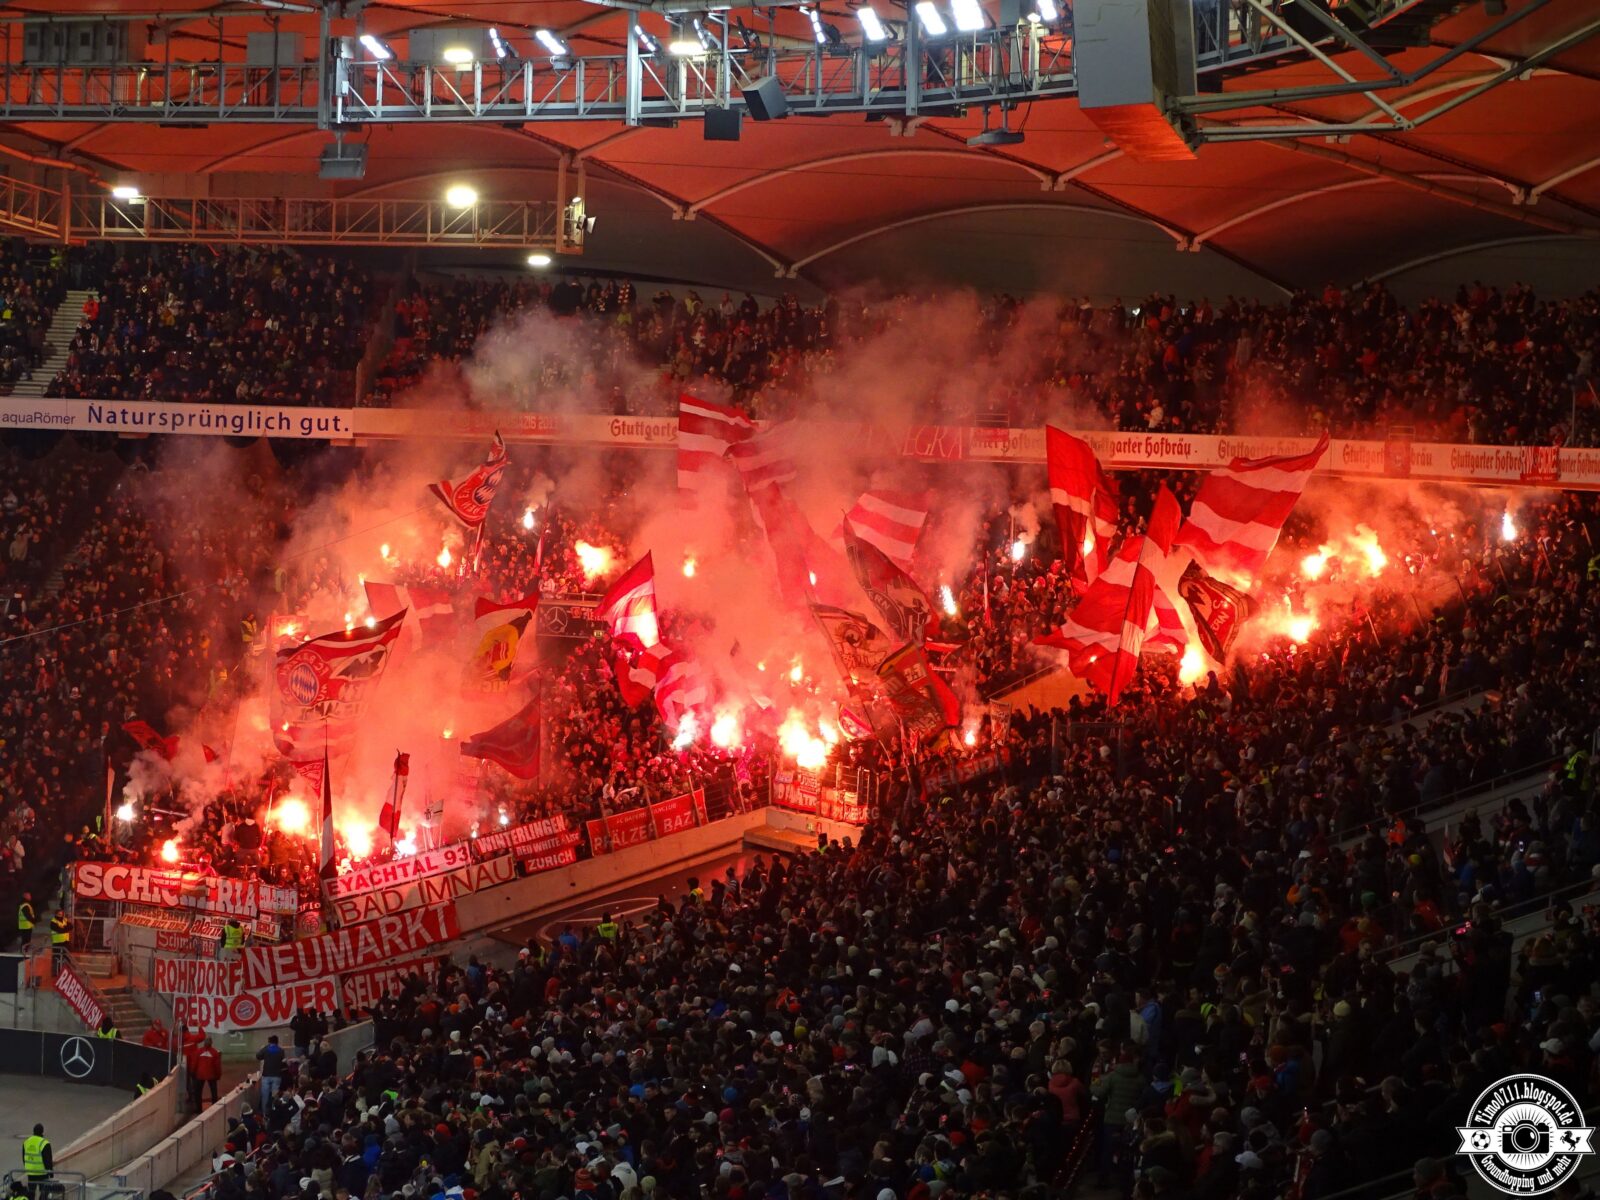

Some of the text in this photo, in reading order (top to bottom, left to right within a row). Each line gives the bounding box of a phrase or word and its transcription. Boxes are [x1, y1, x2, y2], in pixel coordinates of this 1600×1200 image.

[1, 411, 76, 426] aquaRömer
[88, 405, 349, 435] Natursprünglich gut.
[610, 418, 678, 442] Stuttgarte
[1144, 437, 1192, 460] Hofbräu
[1451, 448, 1494, 474] Stuttgarter
[478, 814, 566, 853] WINTERLINGEN
[533, 837, 561, 854] WHITE
[326, 846, 469, 896] EYACHTAL 93
[337, 889, 404, 925] BAD
[417, 855, 514, 904] IMNAU
[246, 904, 450, 987] NEUMARKT
[154, 958, 242, 996] ROHRDORF
